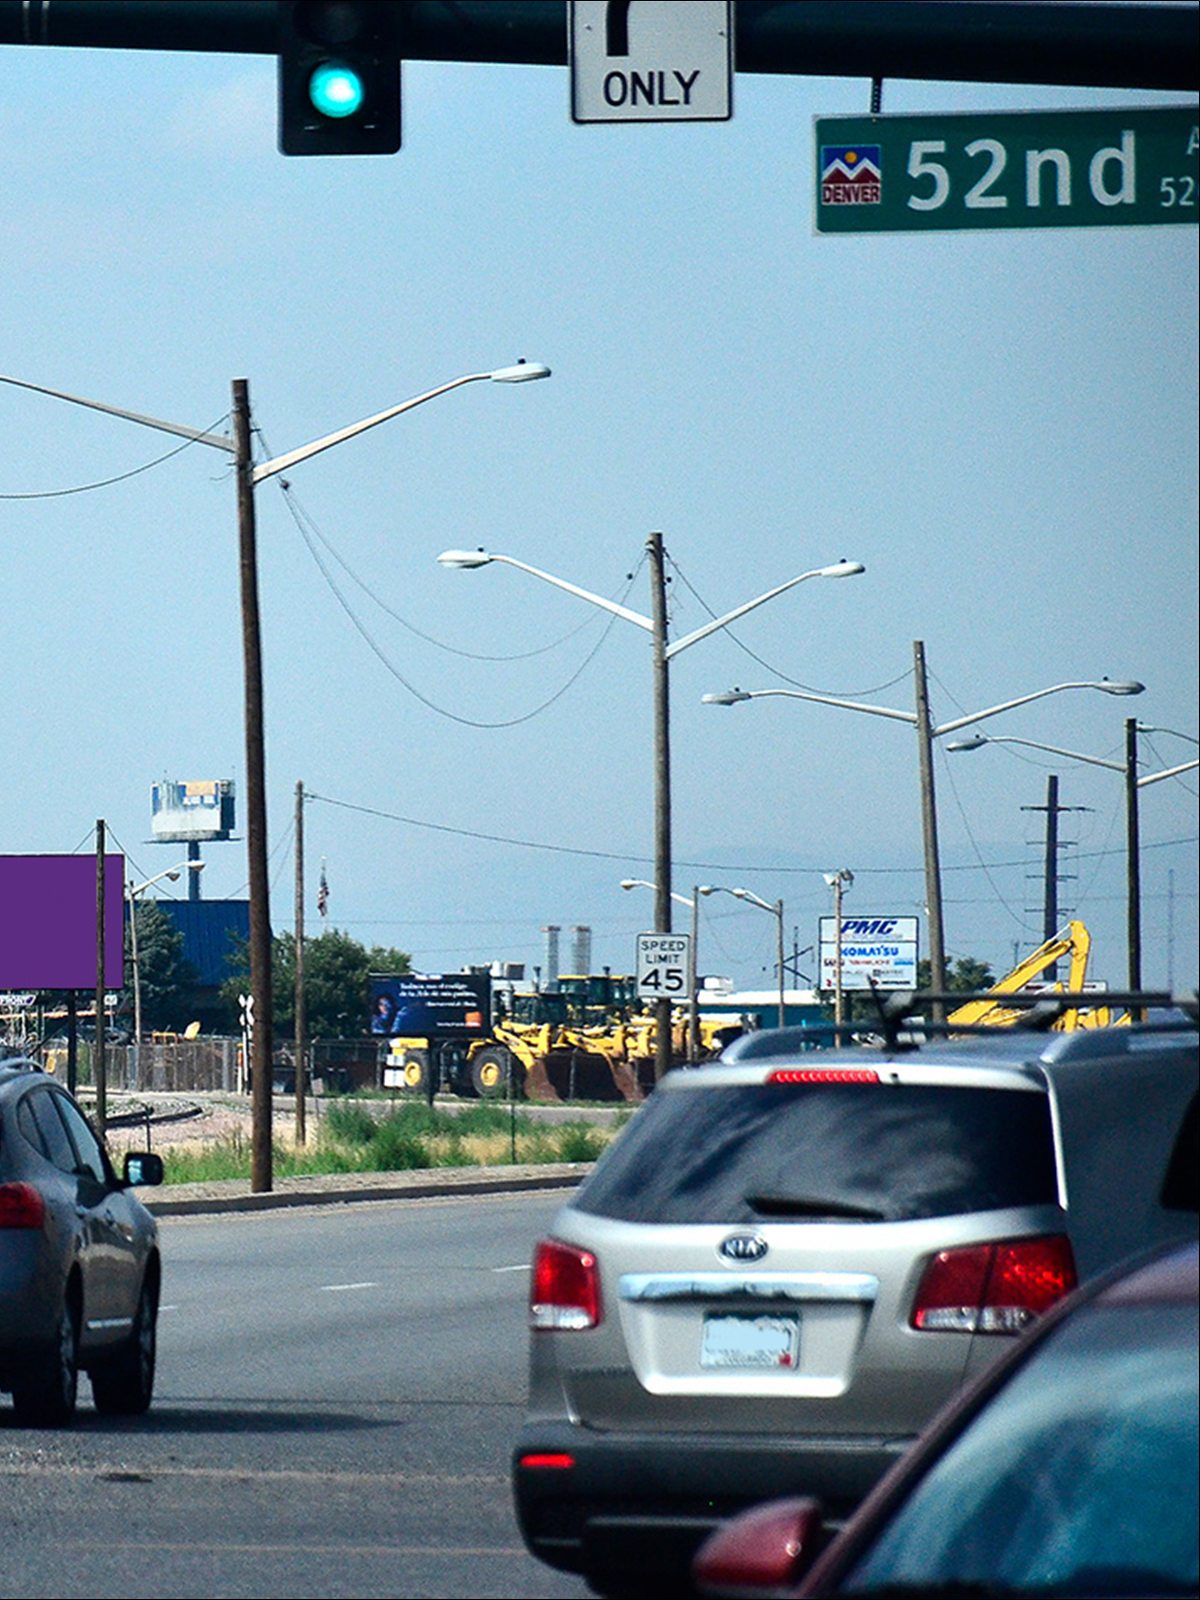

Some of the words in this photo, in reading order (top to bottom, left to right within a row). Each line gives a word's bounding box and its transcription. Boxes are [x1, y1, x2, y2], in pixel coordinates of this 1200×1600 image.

[603, 69, 701, 107] ONLY
[906, 129, 1137, 211] 52nd
[822, 185, 880, 204] DENVER
[1160, 176, 1194, 207] 52
[840, 920, 898, 935] PMC
[640, 940, 686, 952] SPEED
[645, 953, 681, 964] LIMIT
[640, 967, 684, 992] 45
[725, 1239, 758, 1256] KIA
